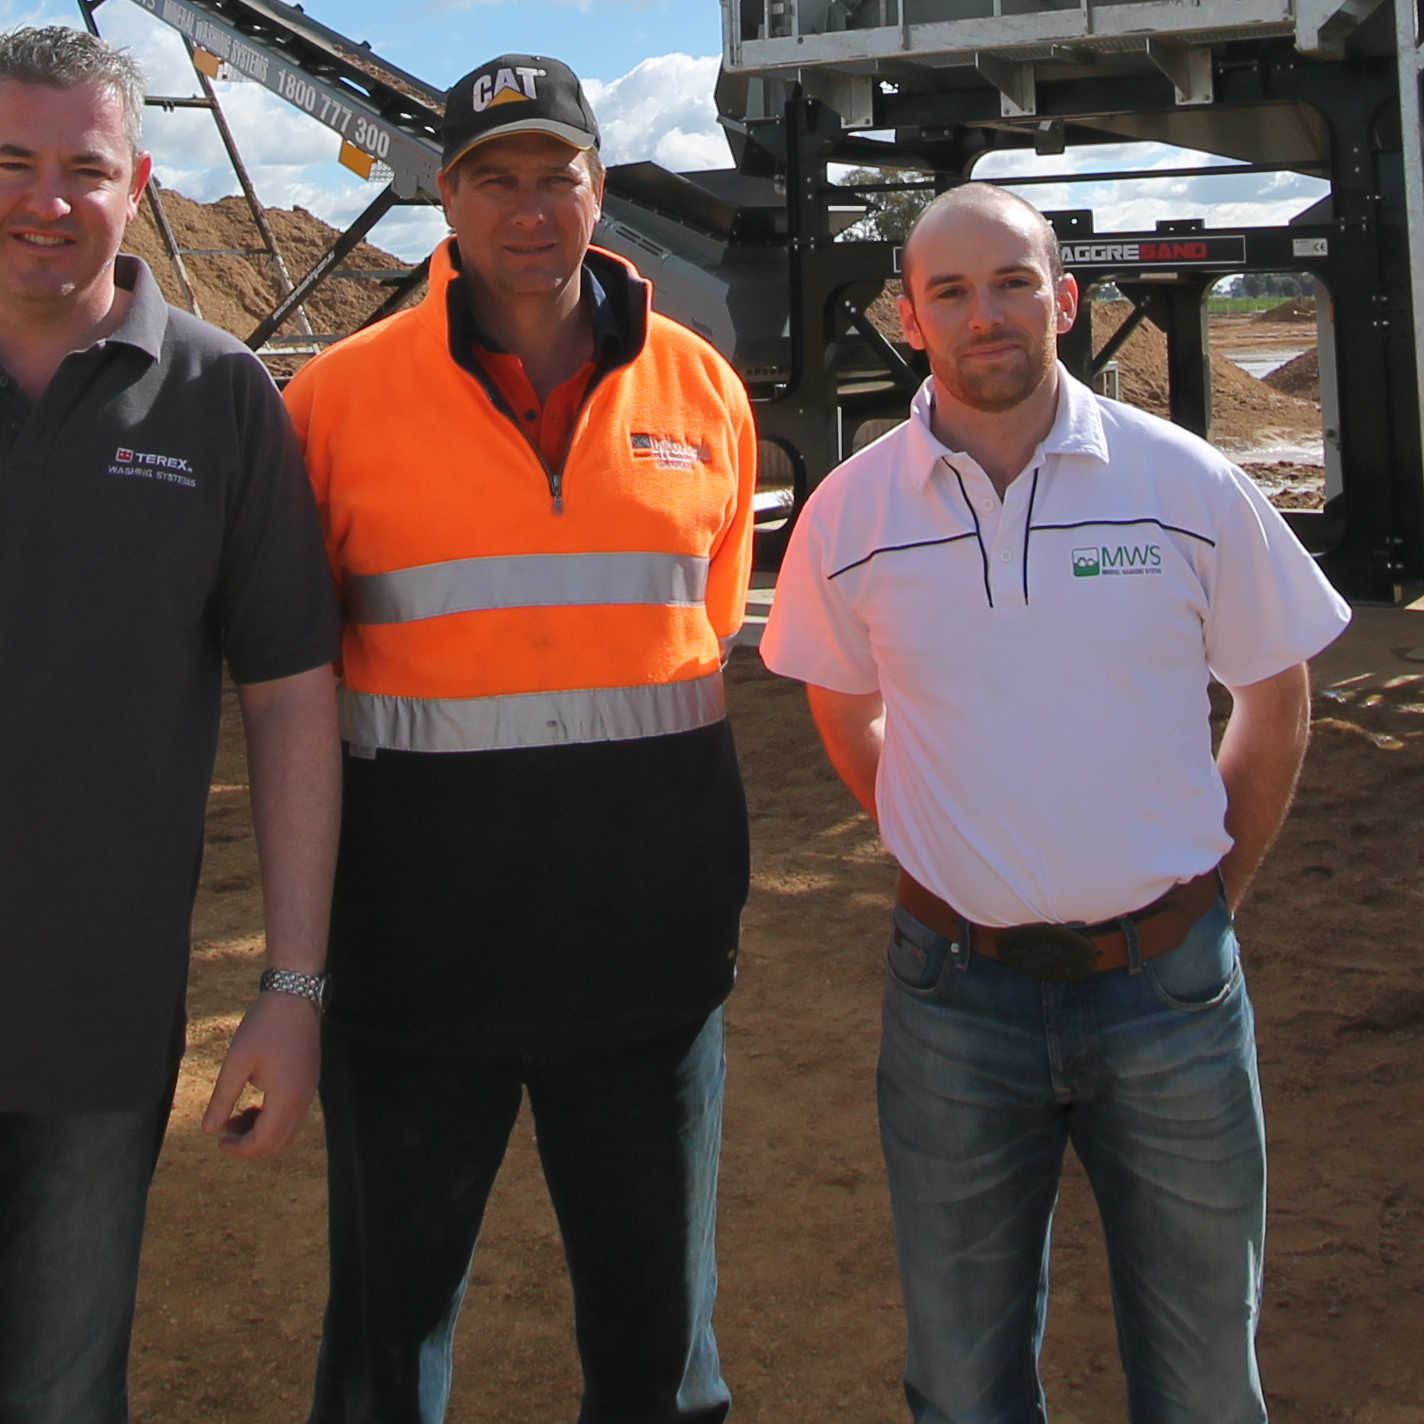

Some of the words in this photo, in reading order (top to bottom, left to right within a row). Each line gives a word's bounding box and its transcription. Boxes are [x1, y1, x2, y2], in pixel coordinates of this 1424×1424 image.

[195, 16, 232, 58] WASHING
[230, 39, 269, 82] SYSTEMS
[278, 69, 316, 112] 1800
[321, 94, 353, 132] 777
[355, 117, 390, 158] 300
[473, 66, 537, 112] CAT
[135, 452, 188, 471] TEREX
[108, 465, 153, 478] WASHING
[156, 471, 196, 487] SYSTEMS
[1102, 545, 1161, 567] MWS
